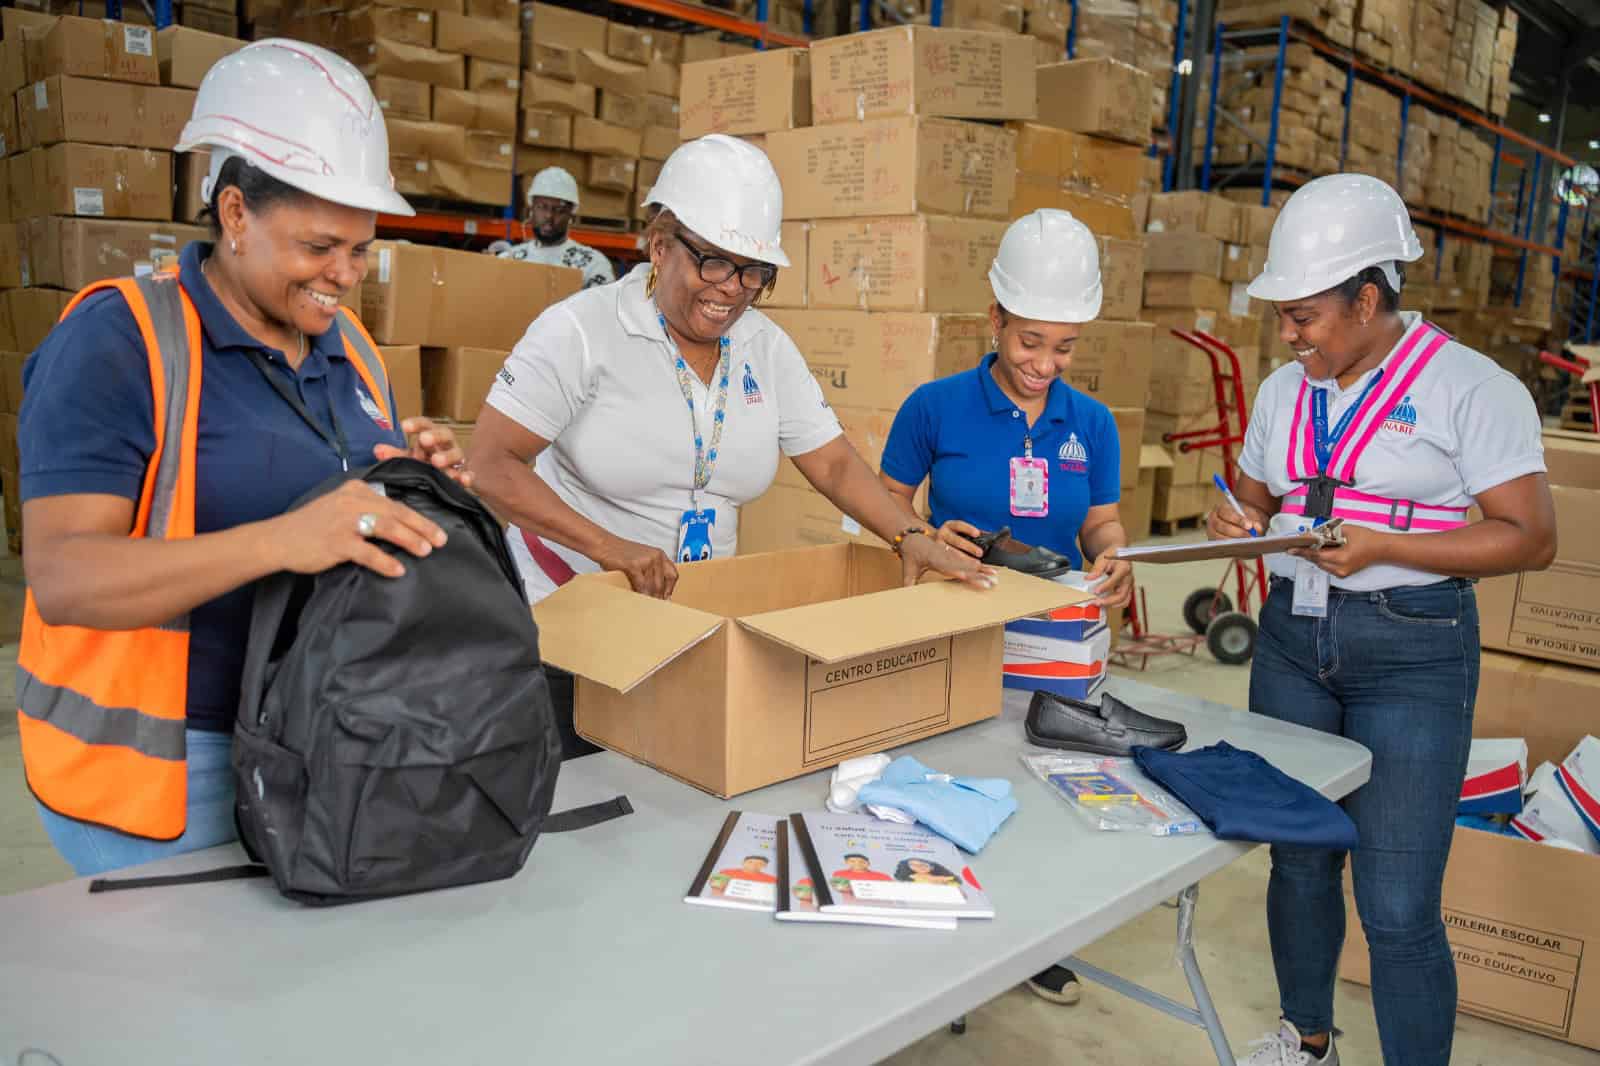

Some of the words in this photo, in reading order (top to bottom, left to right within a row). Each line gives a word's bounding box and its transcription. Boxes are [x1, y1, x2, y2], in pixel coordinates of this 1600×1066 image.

[825, 663, 873, 684] CENTRO
[876, 647, 937, 672] EDUCATIVO
[1444, 913, 1498, 936] UTILERIA
[1501, 929, 1561, 950] ESCOLAR
[1484, 958, 1556, 983] EDUCATIVO
